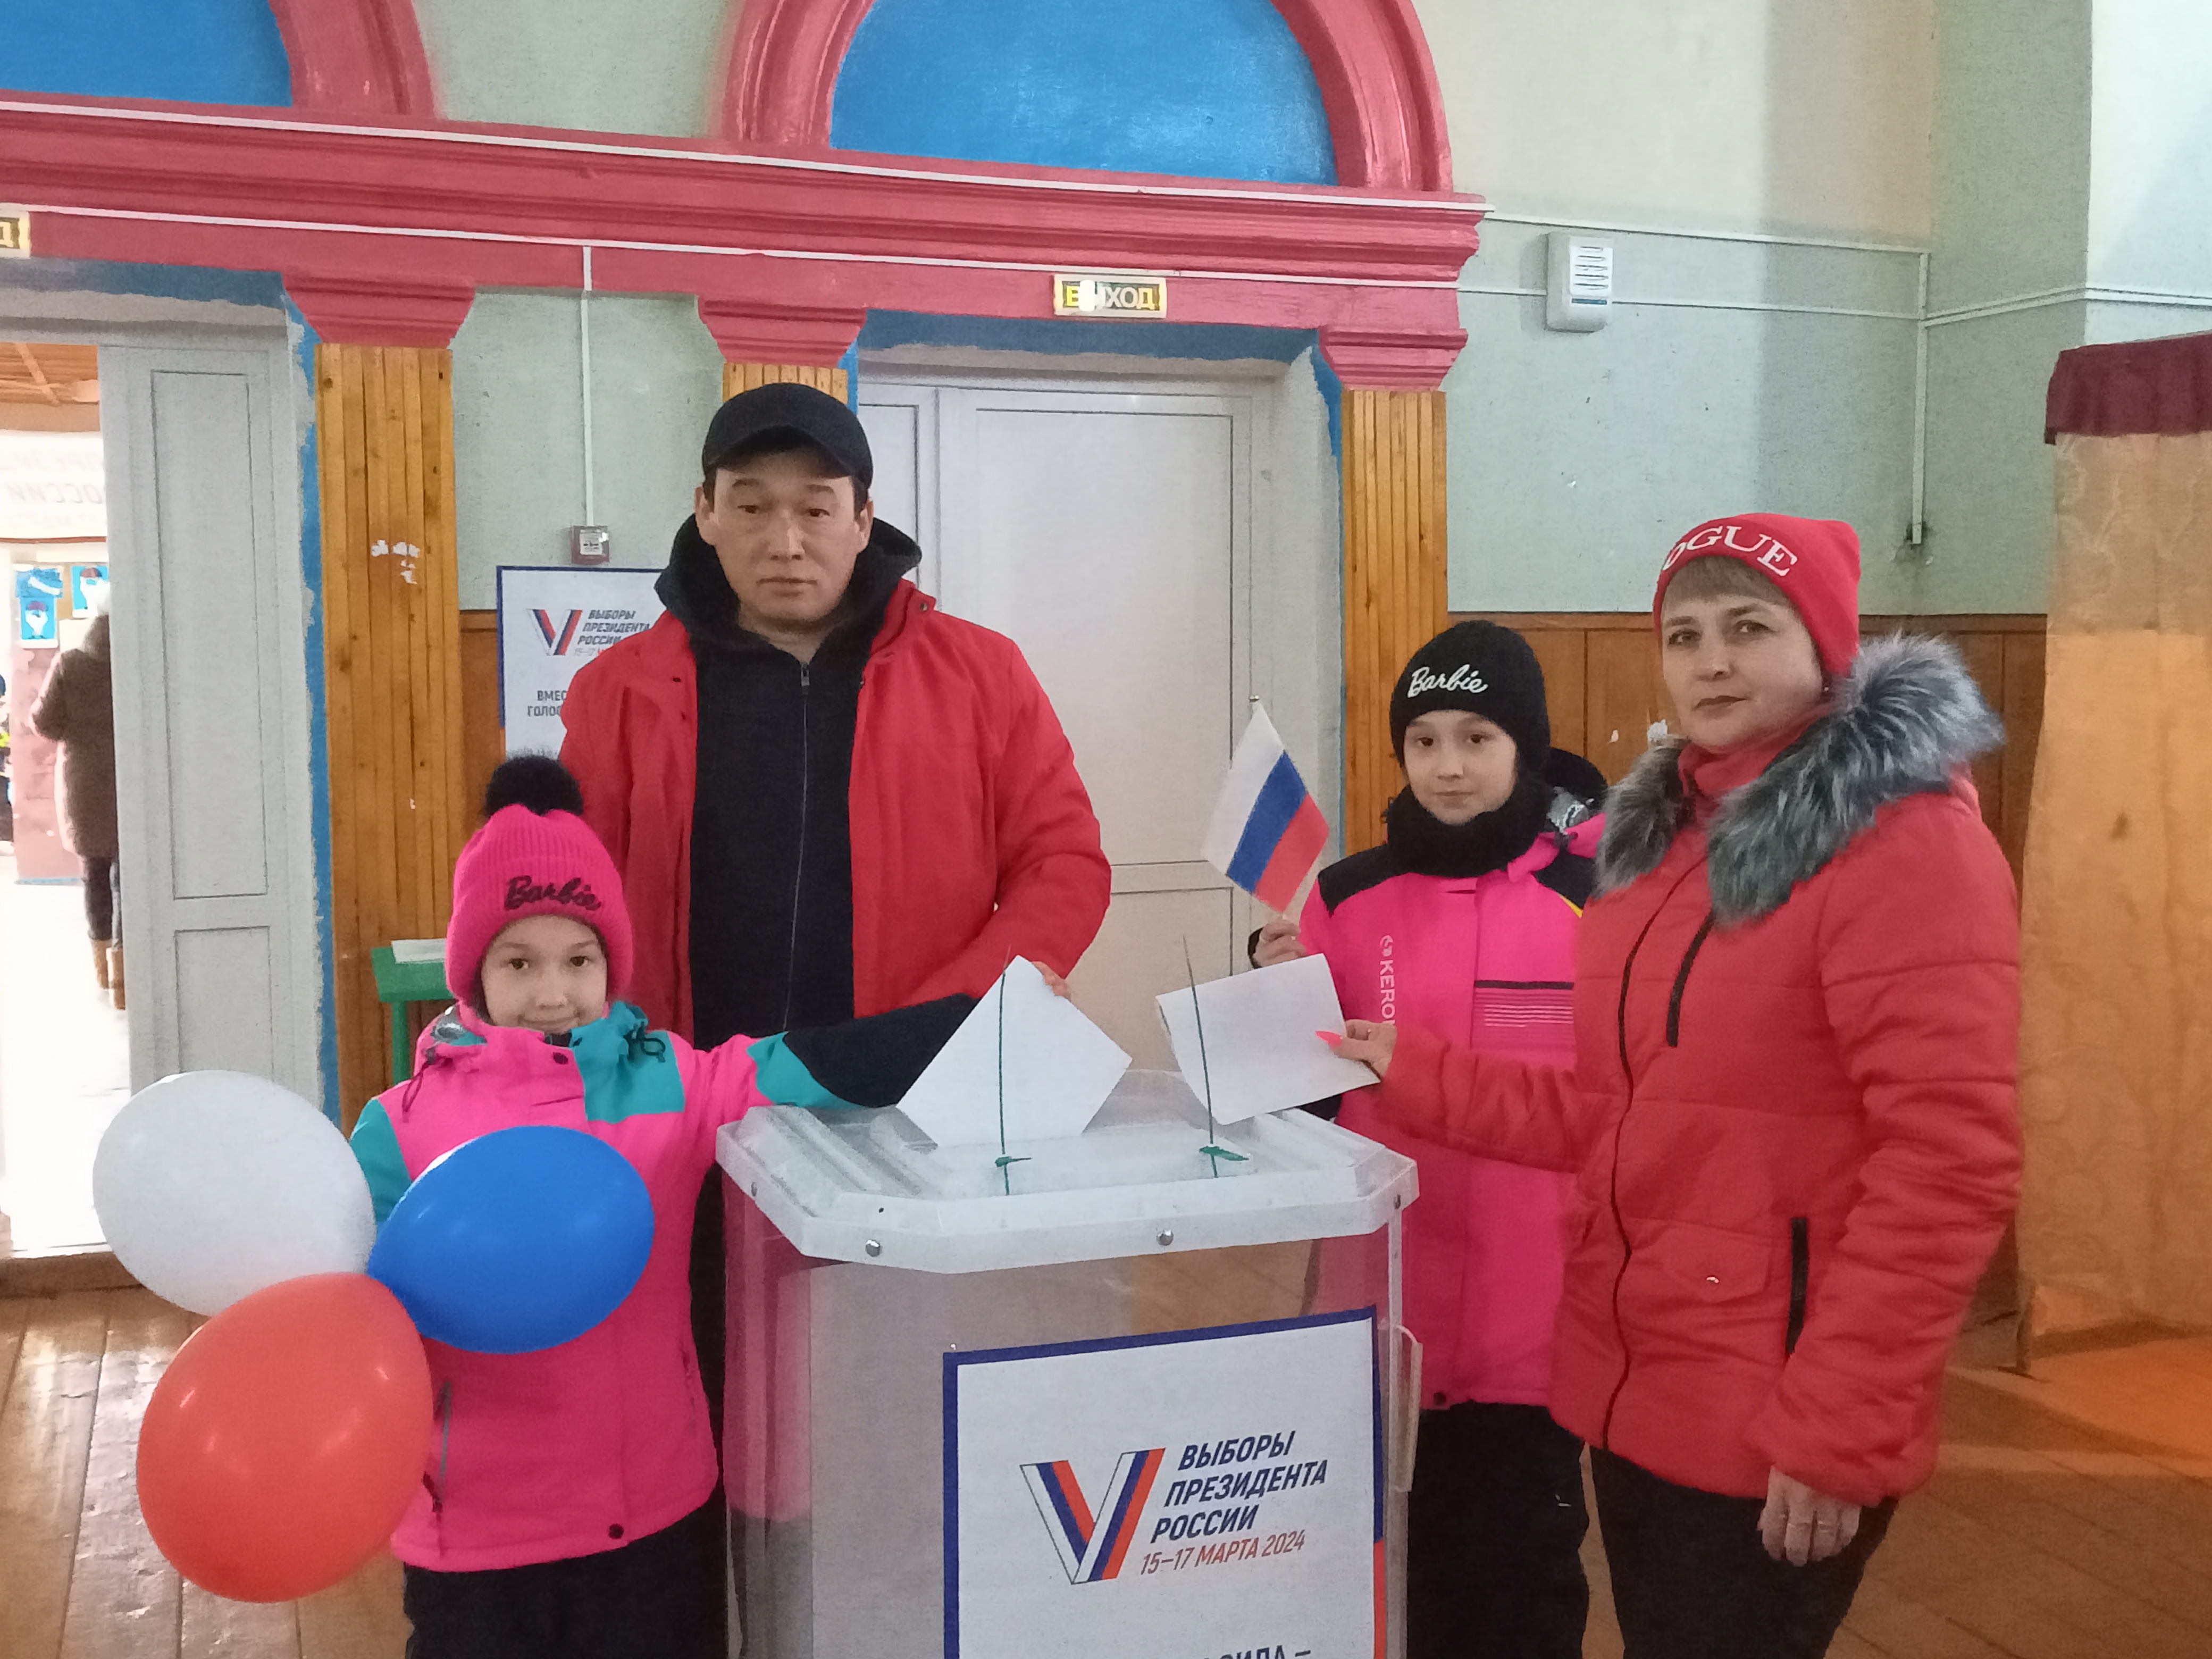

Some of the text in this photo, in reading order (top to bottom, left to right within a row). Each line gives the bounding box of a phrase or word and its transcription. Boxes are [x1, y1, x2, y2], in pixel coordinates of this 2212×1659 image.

[582, 623, 650, 633] ПРЕЗИДЕНТА
[588, 609, 636, 619] ВЫБОРЫ
[1407, 664, 1489, 698] Barbie
[505, 875, 602, 911] Barbie
[1380, 959, 1396, 1025] KERO
[1178, 1431, 1295, 1471] ВЫБОРЫ
[1163, 1460, 1328, 1507] ПРЕЗИДЕНТА
[1150, 1504, 1260, 1544] РОССИИ
[1194, 1537, 1259, 1568] МАРТА
[1261, 1529, 1306, 1557] 2024
